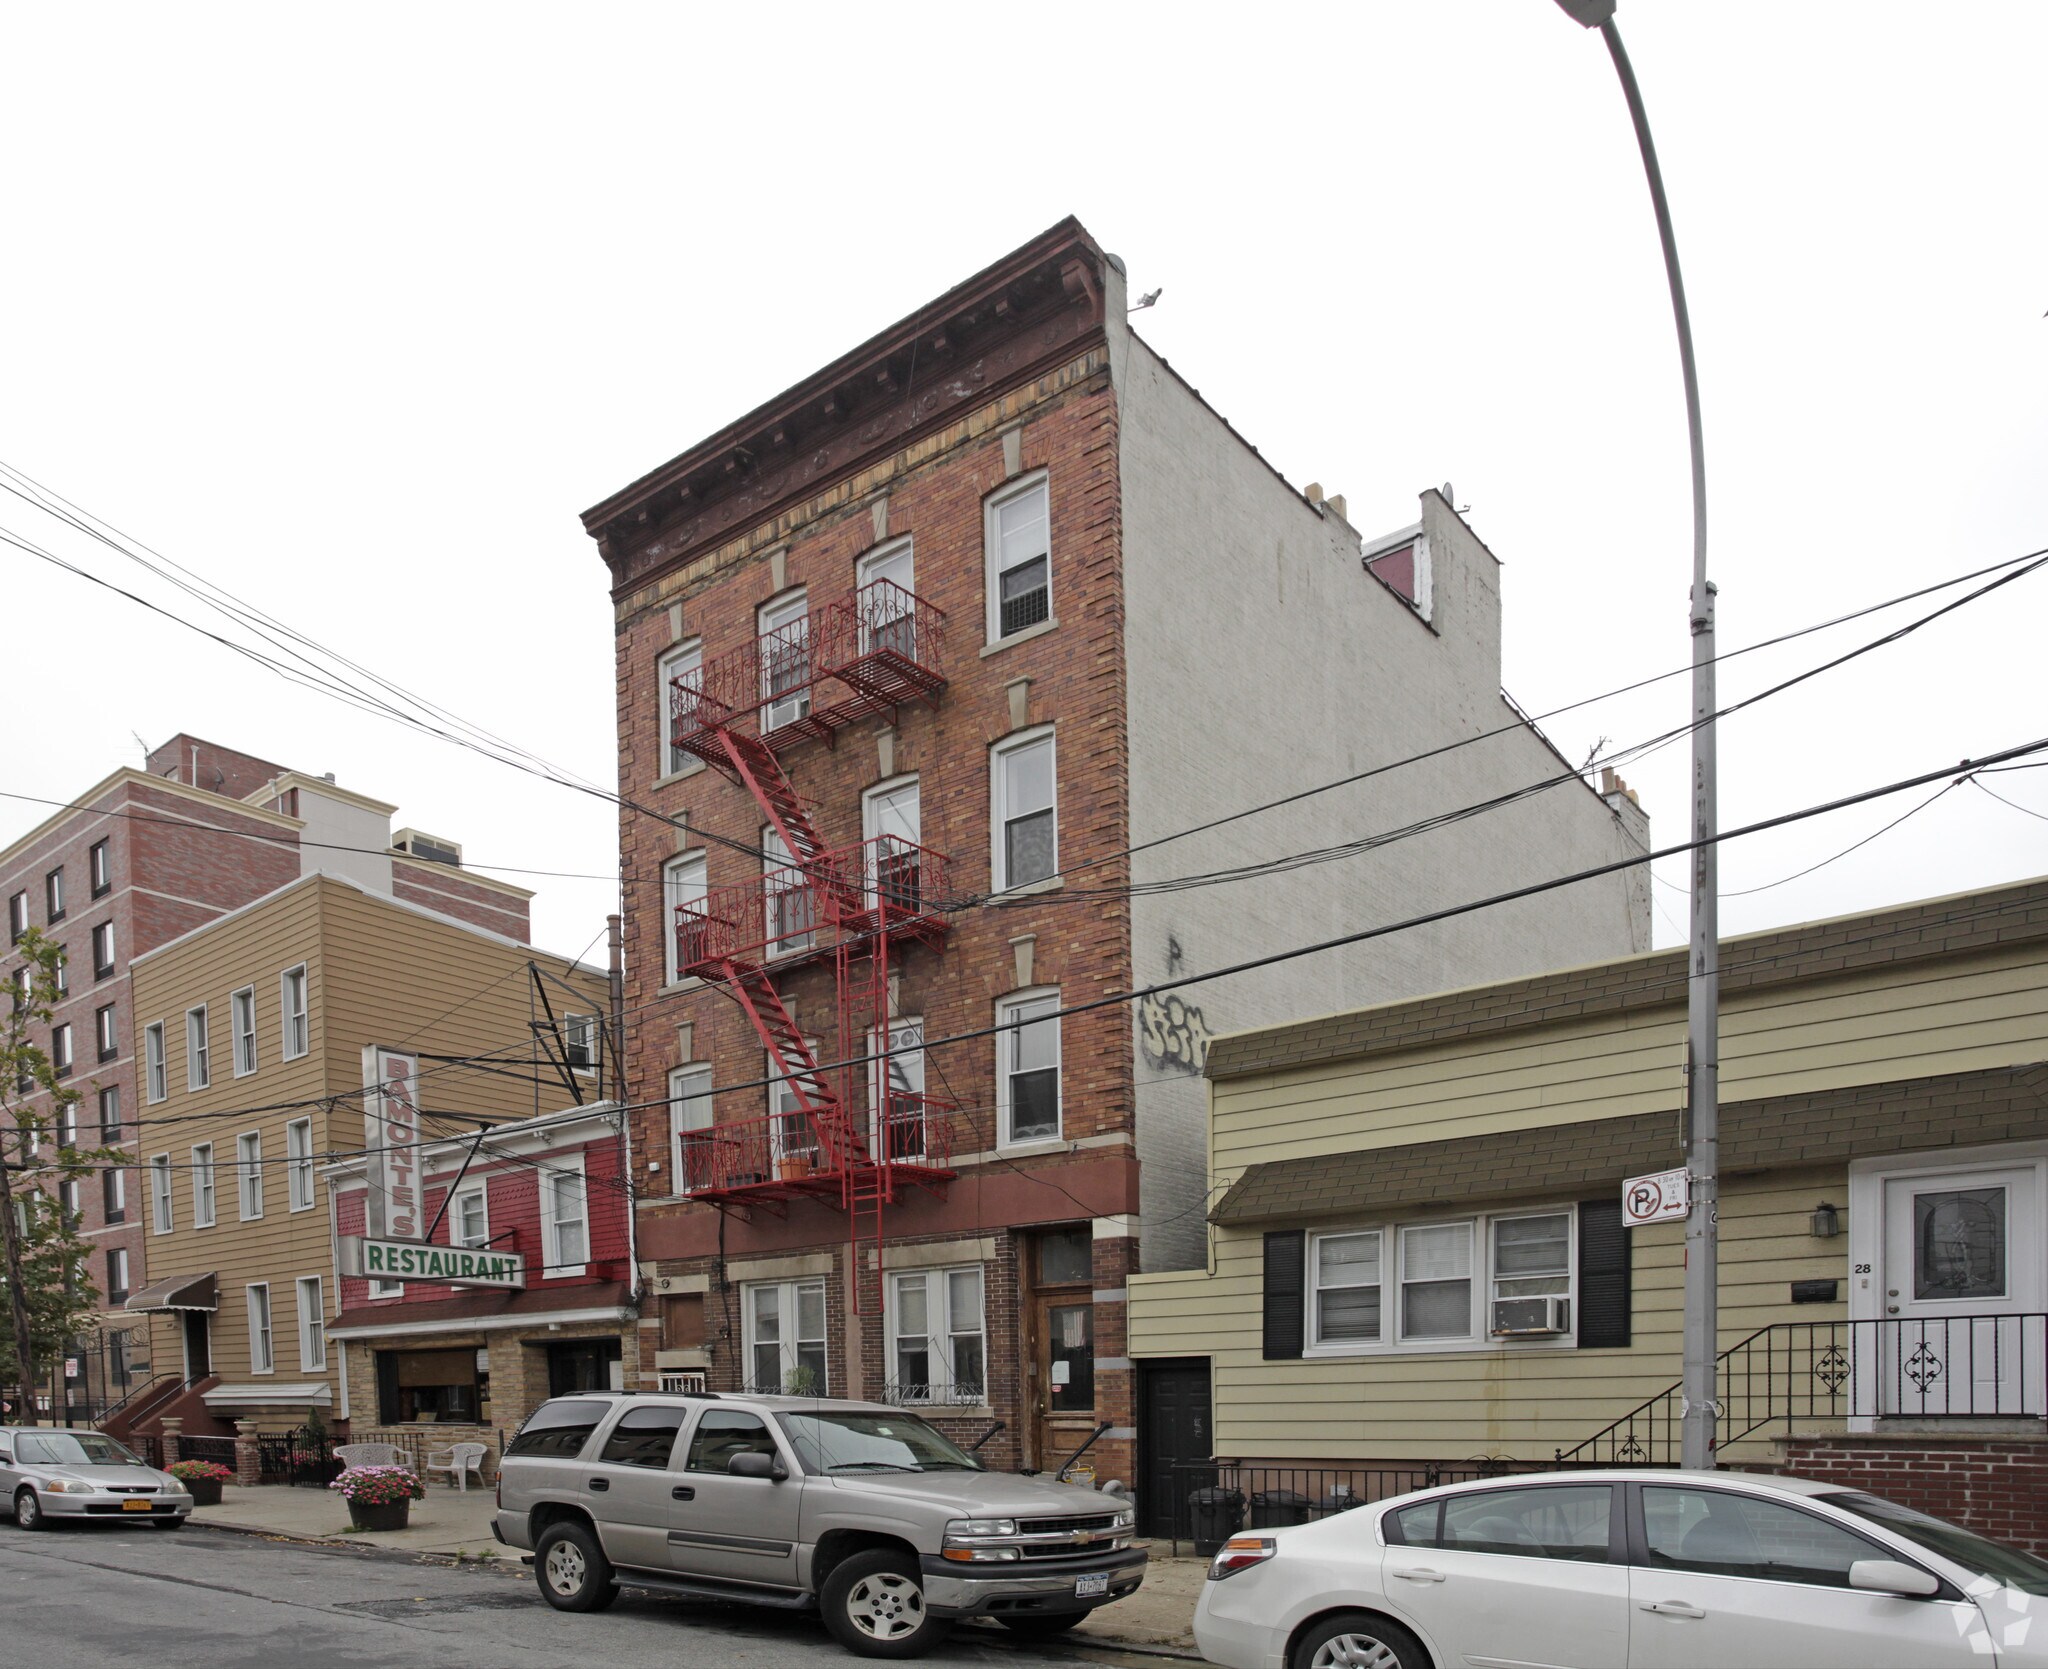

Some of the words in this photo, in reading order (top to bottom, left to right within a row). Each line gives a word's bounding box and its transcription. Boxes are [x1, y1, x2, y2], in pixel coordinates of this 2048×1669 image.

[386, 1057, 417, 1236] BAMONTE'S
[368, 1245, 517, 1282] RESTAURANT
[1855, 1264, 1871, 1274] 28
